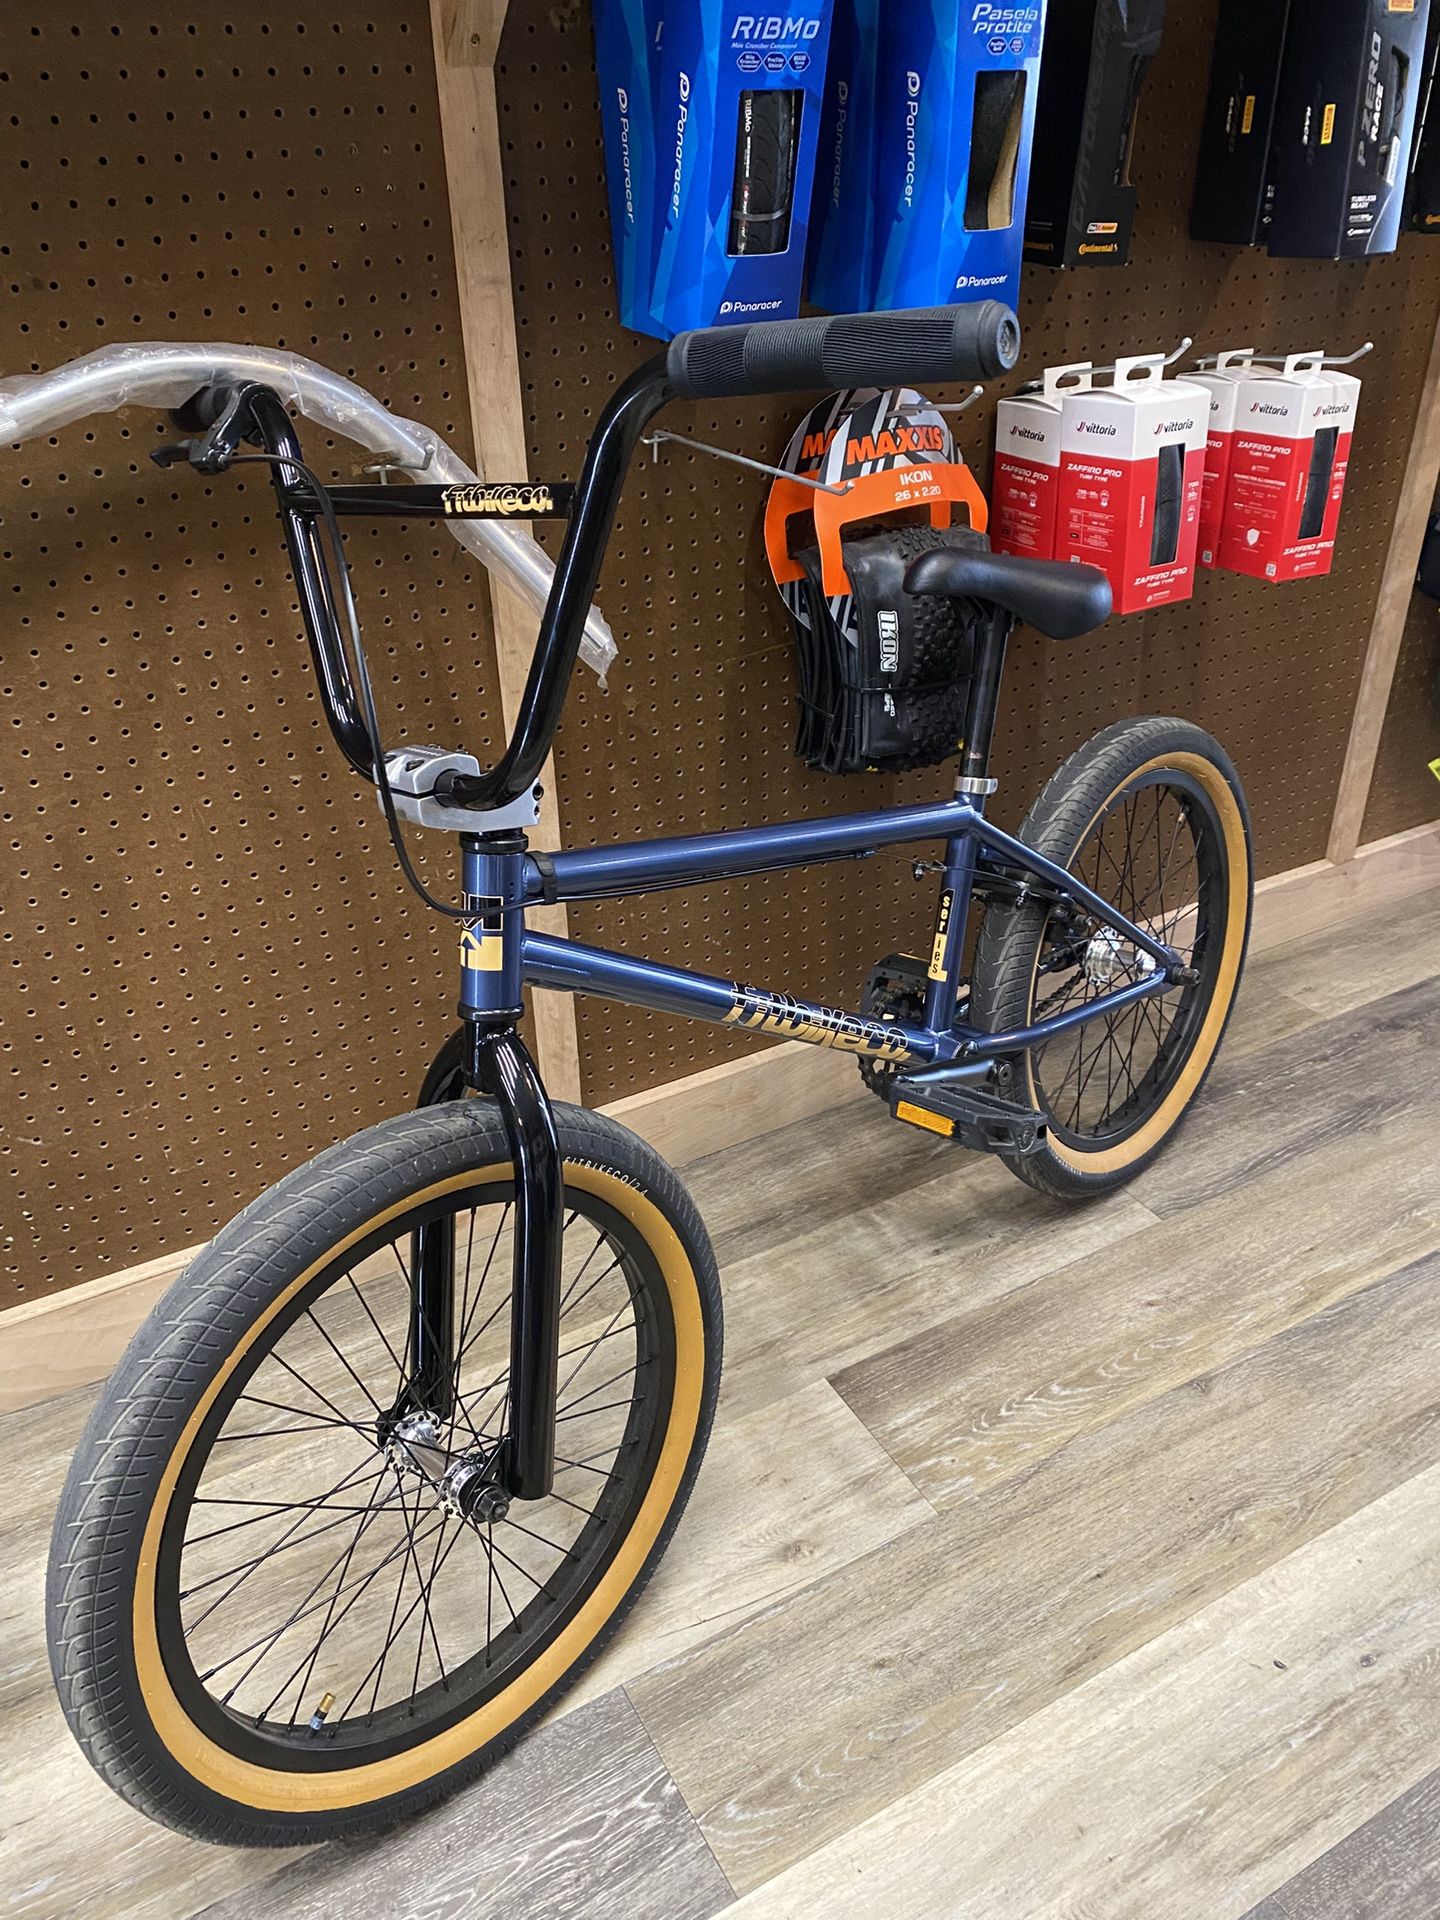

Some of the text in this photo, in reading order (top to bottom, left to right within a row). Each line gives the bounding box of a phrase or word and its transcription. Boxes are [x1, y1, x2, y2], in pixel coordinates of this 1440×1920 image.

[972, 3, 1038, 20] Pasela
[731, 16, 820, 39] RiBMo
[1362, 31, 1381, 136] ZERO
[1370, 82, 1383, 141] RACE
[672, 104, 688, 219] Panaracer
[833, 108, 846, 208] Panaracer
[904, 101, 918, 207] Panaracer
[620, 117, 634, 223] Panaracer
[968, 274, 1008, 287] Panaracer
[734, 300, 782, 312] Panaracer
[1260, 403, 1288, 416] vittoria
[1322, 403, 1350, 415] vittoria
[1018, 427, 1045, 442] vittoria
[1086, 423, 1117, 436] vittoria
[1164, 419, 1193, 433] vittoria
[846, 426, 942, 465] MAXXIS
[900, 470, 933, 486] IKON
[895, 485, 941, 502] 26 x 2.20
[878, 611, 899, 672] IKON
